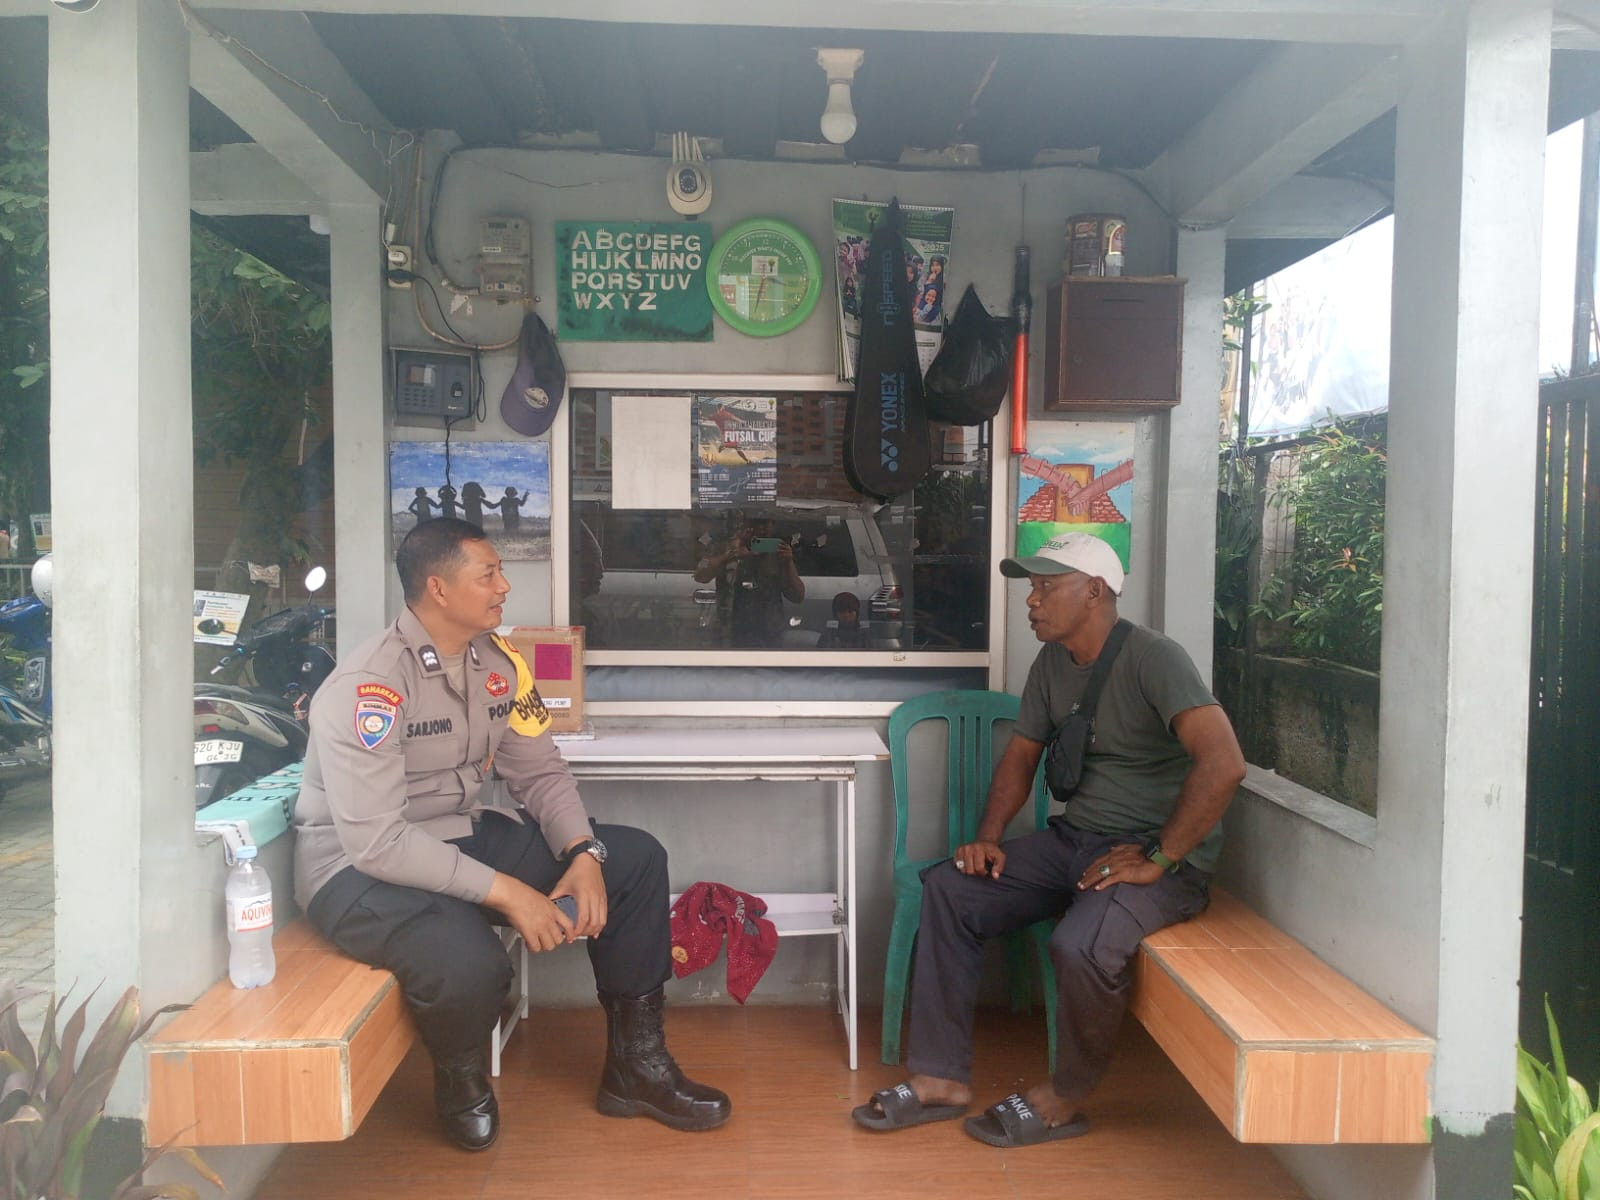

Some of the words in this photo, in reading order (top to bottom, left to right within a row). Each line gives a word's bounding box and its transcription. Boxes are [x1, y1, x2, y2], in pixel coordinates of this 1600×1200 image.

[571, 230, 701, 251] ABCDEFG
[571, 251, 702, 271] HIJKLMNO
[881, 372, 898, 432] YONEX
[724, 430, 755, 442] FUTSAL
[758, 430, 776, 442] CUP
[406, 718, 453, 738] SARJONO
